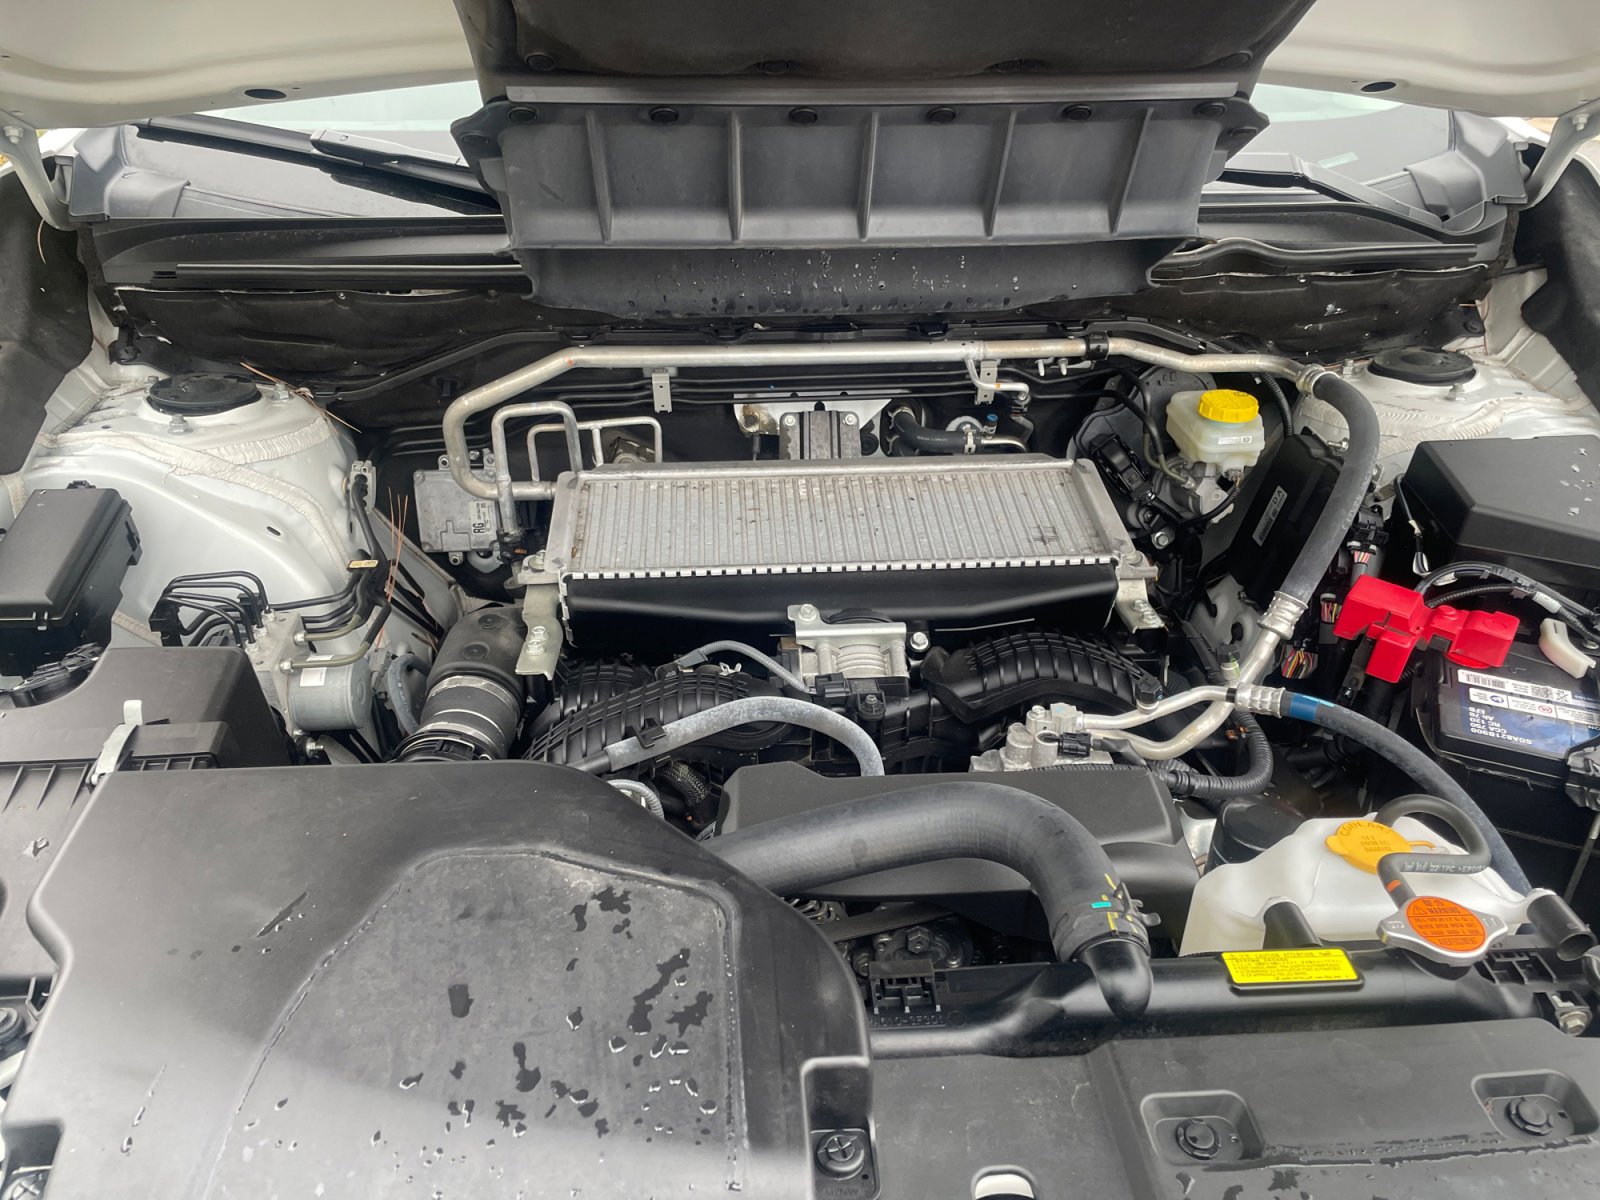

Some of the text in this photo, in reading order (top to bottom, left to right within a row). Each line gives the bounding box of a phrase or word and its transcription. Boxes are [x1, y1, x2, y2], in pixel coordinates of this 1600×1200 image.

[472, 522, 485, 533] RG
[1469, 707, 1486, 715] EFB
[1470, 717, 1486, 725] 120
[1470, 722, 1507, 734] CCA 750
[1427, 906, 1461, 915] WARNING
